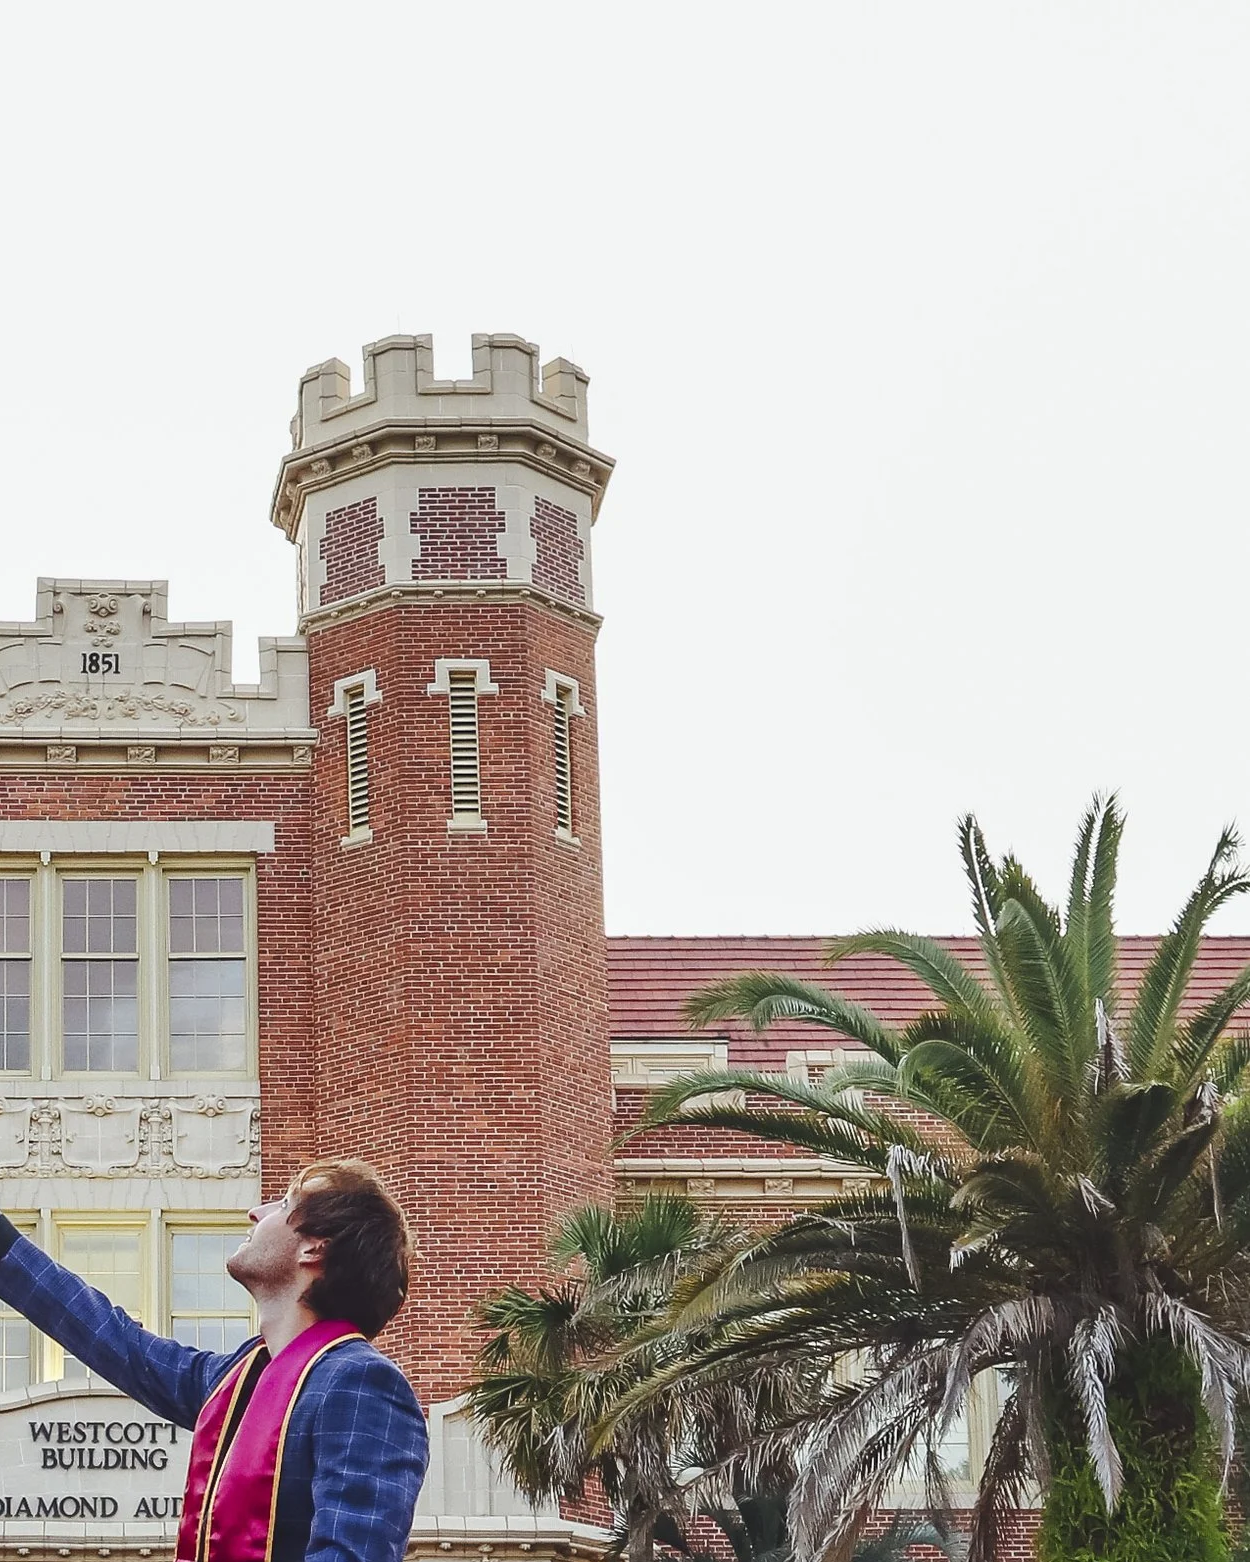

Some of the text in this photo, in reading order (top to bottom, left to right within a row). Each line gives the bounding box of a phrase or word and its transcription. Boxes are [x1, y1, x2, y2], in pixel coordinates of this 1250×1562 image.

[80, 652, 121, 675] 1851
[28, 1421, 178, 1445] WESTCOTT
[41, 1447, 169, 1471] BUILDING
